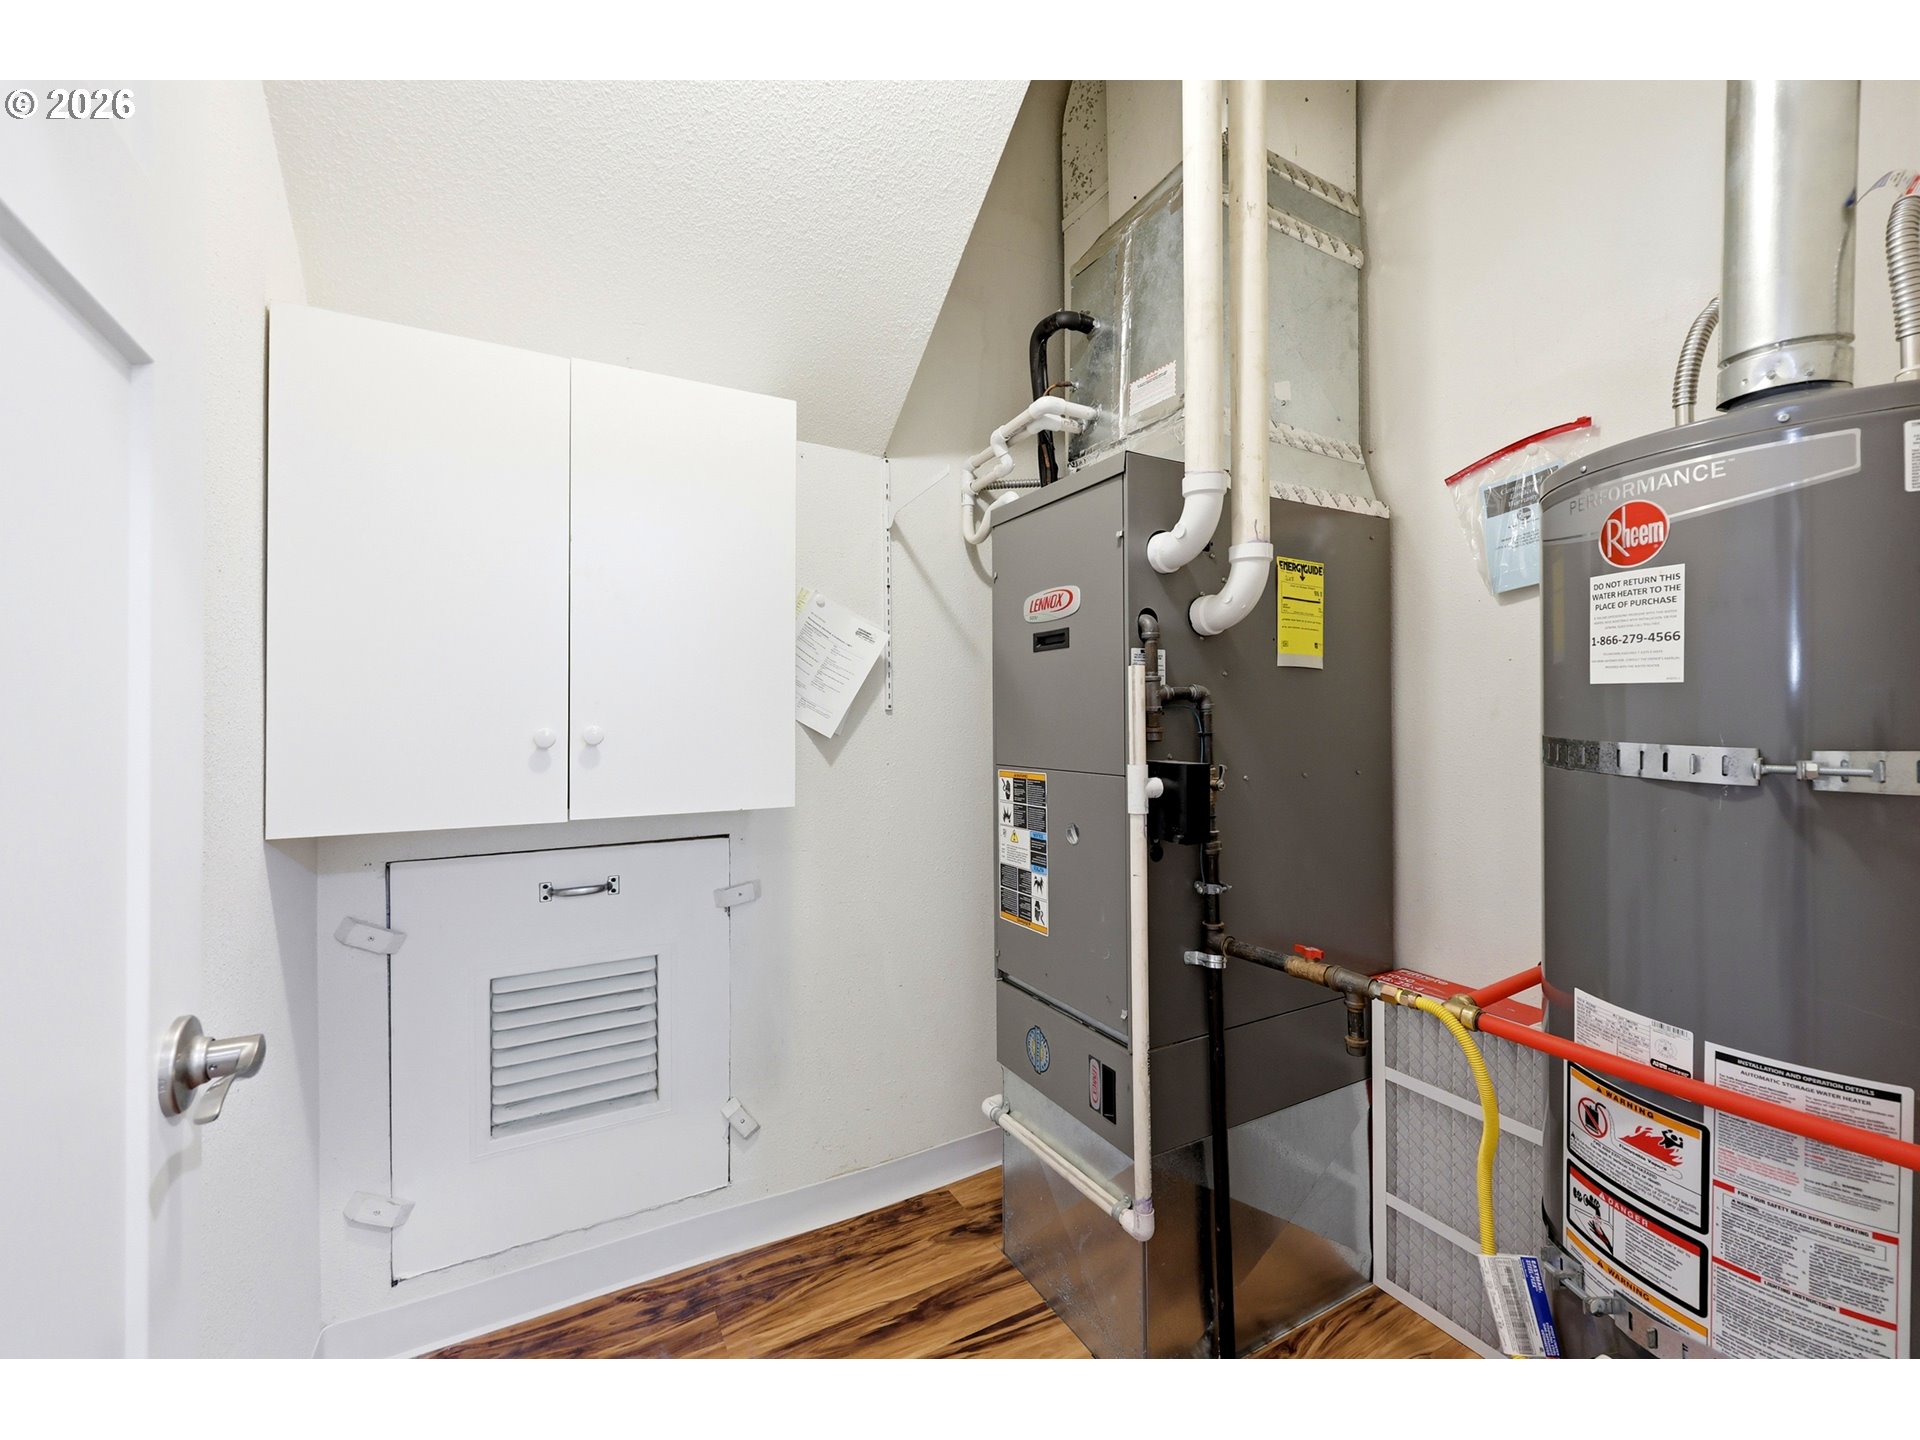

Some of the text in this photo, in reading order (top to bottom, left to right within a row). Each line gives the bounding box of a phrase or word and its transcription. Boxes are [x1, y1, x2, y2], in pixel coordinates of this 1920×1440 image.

[1569, 460, 1727, 515] PERFORMANCE
[1606, 505, 1664, 558] Rheem
[1592, 583, 1682, 601] WATER HEATER TO THE
[1605, 580, 1621, 589] NOT
[1623, 576, 1657, 586] RETURN
[1659, 573, 1681, 582] THIS
[1029, 592, 1064, 613] LENNOX
[1595, 595, 1677, 611] PLACE OF PURCHASE
[1592, 630, 1681, 647] 1-866-279-4566
[1737, 1059, 1875, 1096] INSTALLATION AND OPERATION DETAILS
[1740, 1070, 1872, 1106] AUTOMATIC STORAGE WATER HEATER
[1606, 1092, 1654, 1119] WARNING
[1608, 1199, 1649, 1227] DANGER
[1767, 1200, 1789, 1213] SAFETY
[1607, 1268, 1650, 1301] WARNING
